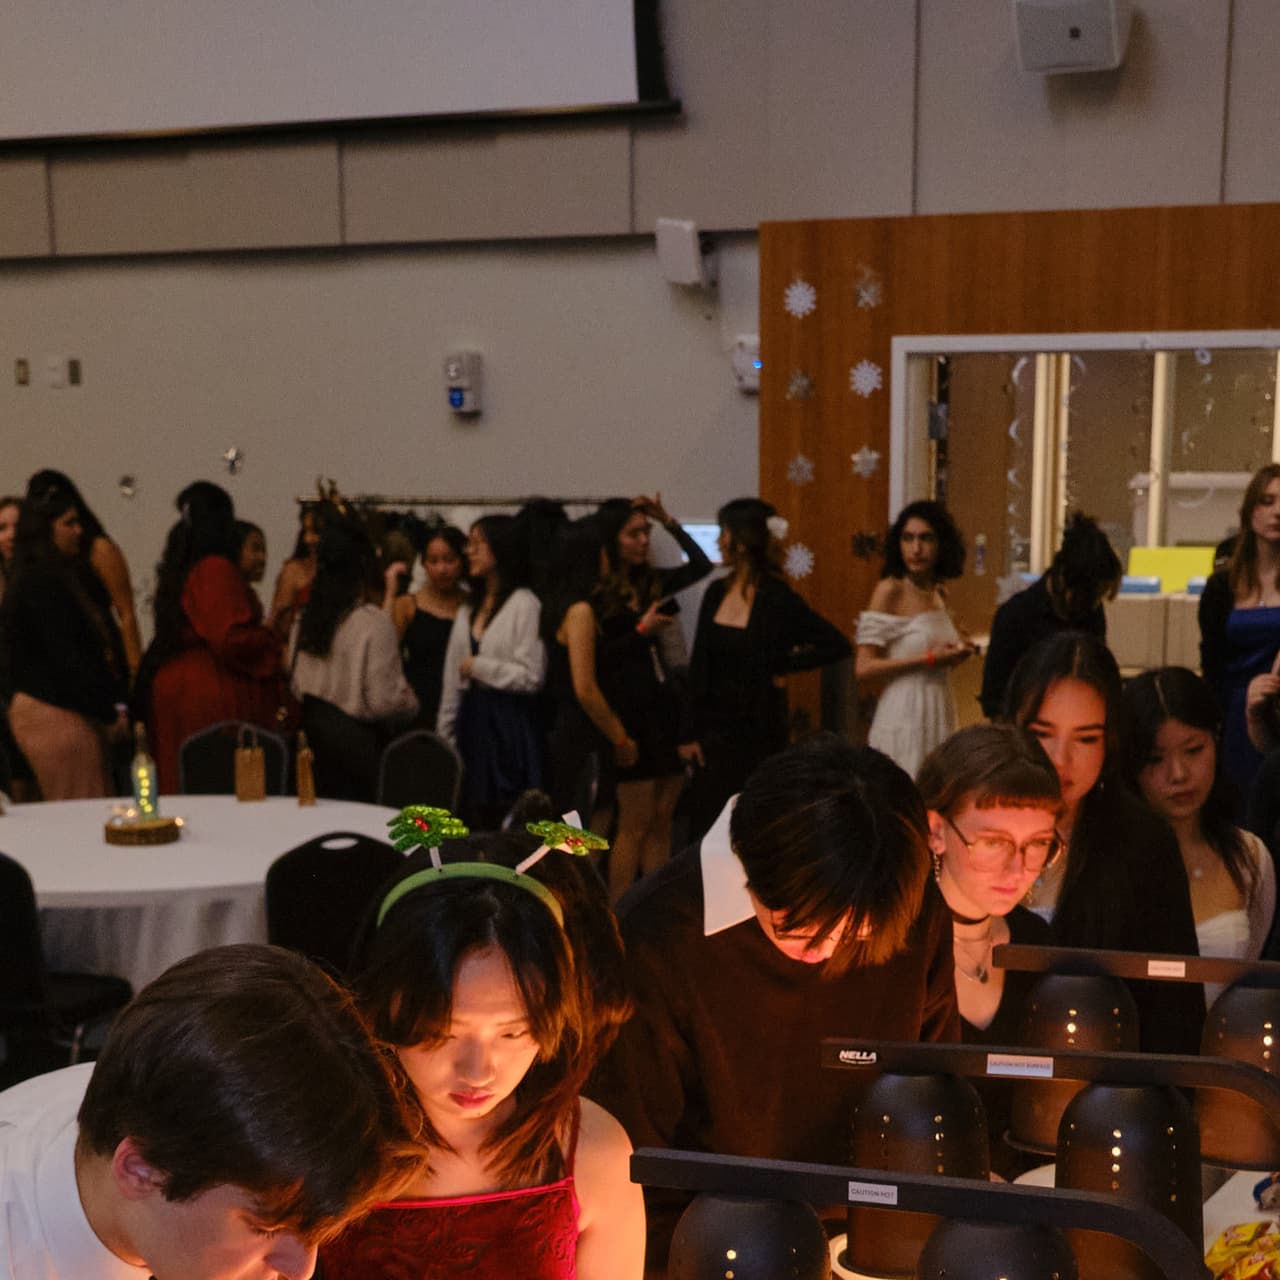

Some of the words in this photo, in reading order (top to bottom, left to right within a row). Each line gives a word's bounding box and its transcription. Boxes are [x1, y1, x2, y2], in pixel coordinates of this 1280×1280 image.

[839, 1050, 877, 1061] NELLA
[851, 1188, 879, 1197] CAUTION
[880, 1192, 895, 1200] HOT
